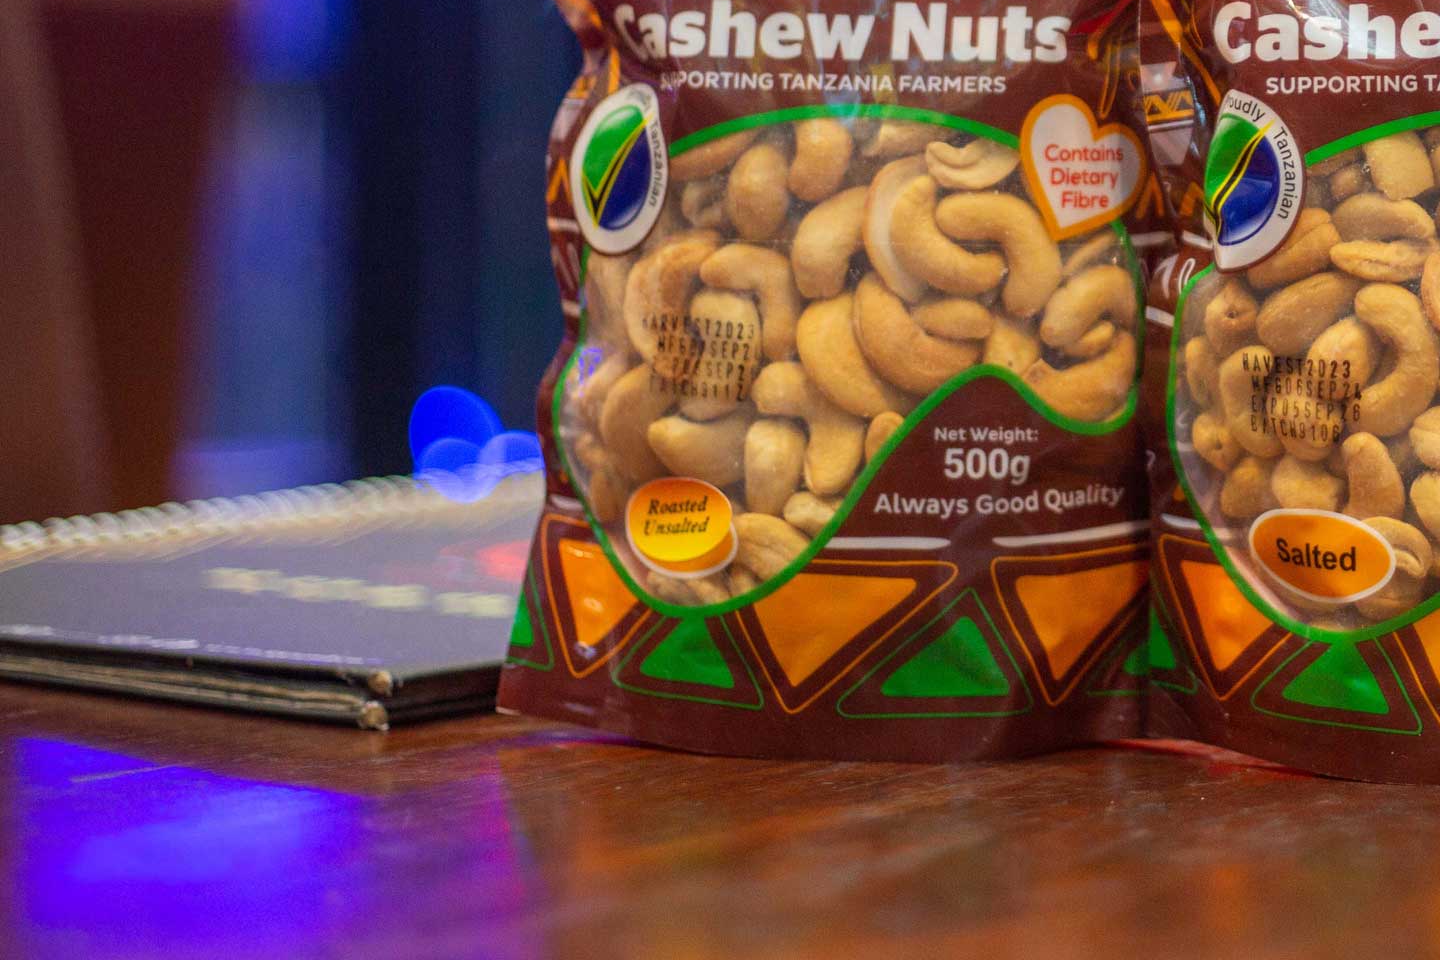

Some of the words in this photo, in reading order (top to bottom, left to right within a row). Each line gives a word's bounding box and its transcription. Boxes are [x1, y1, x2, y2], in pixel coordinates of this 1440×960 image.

[890, 1, 1071, 62] Nuts
[779, 72, 894, 92] TANZANIA
[898, 75, 1007, 94] FARMERS
[1265, 73, 1418, 95] SUPPORTING
[1044, 142, 1124, 164] Contains
[1050, 166, 1119, 190] Dietary
[1273, 126, 1298, 219] Tanzanian
[1061, 188, 1109, 210] Fibre
[934, 426, 965, 442] Net
[970, 426, 1039, 444] Weight:
[943, 447, 1030, 485] 500g
[648, 495, 708, 516] Roasted
[874, 493, 968, 518] Always
[976, 490, 1039, 514] Good
[1044, 483, 1125, 513] Quality
[643, 516, 709, 537] Unsalted
[1276, 538, 1357, 573] Salted
